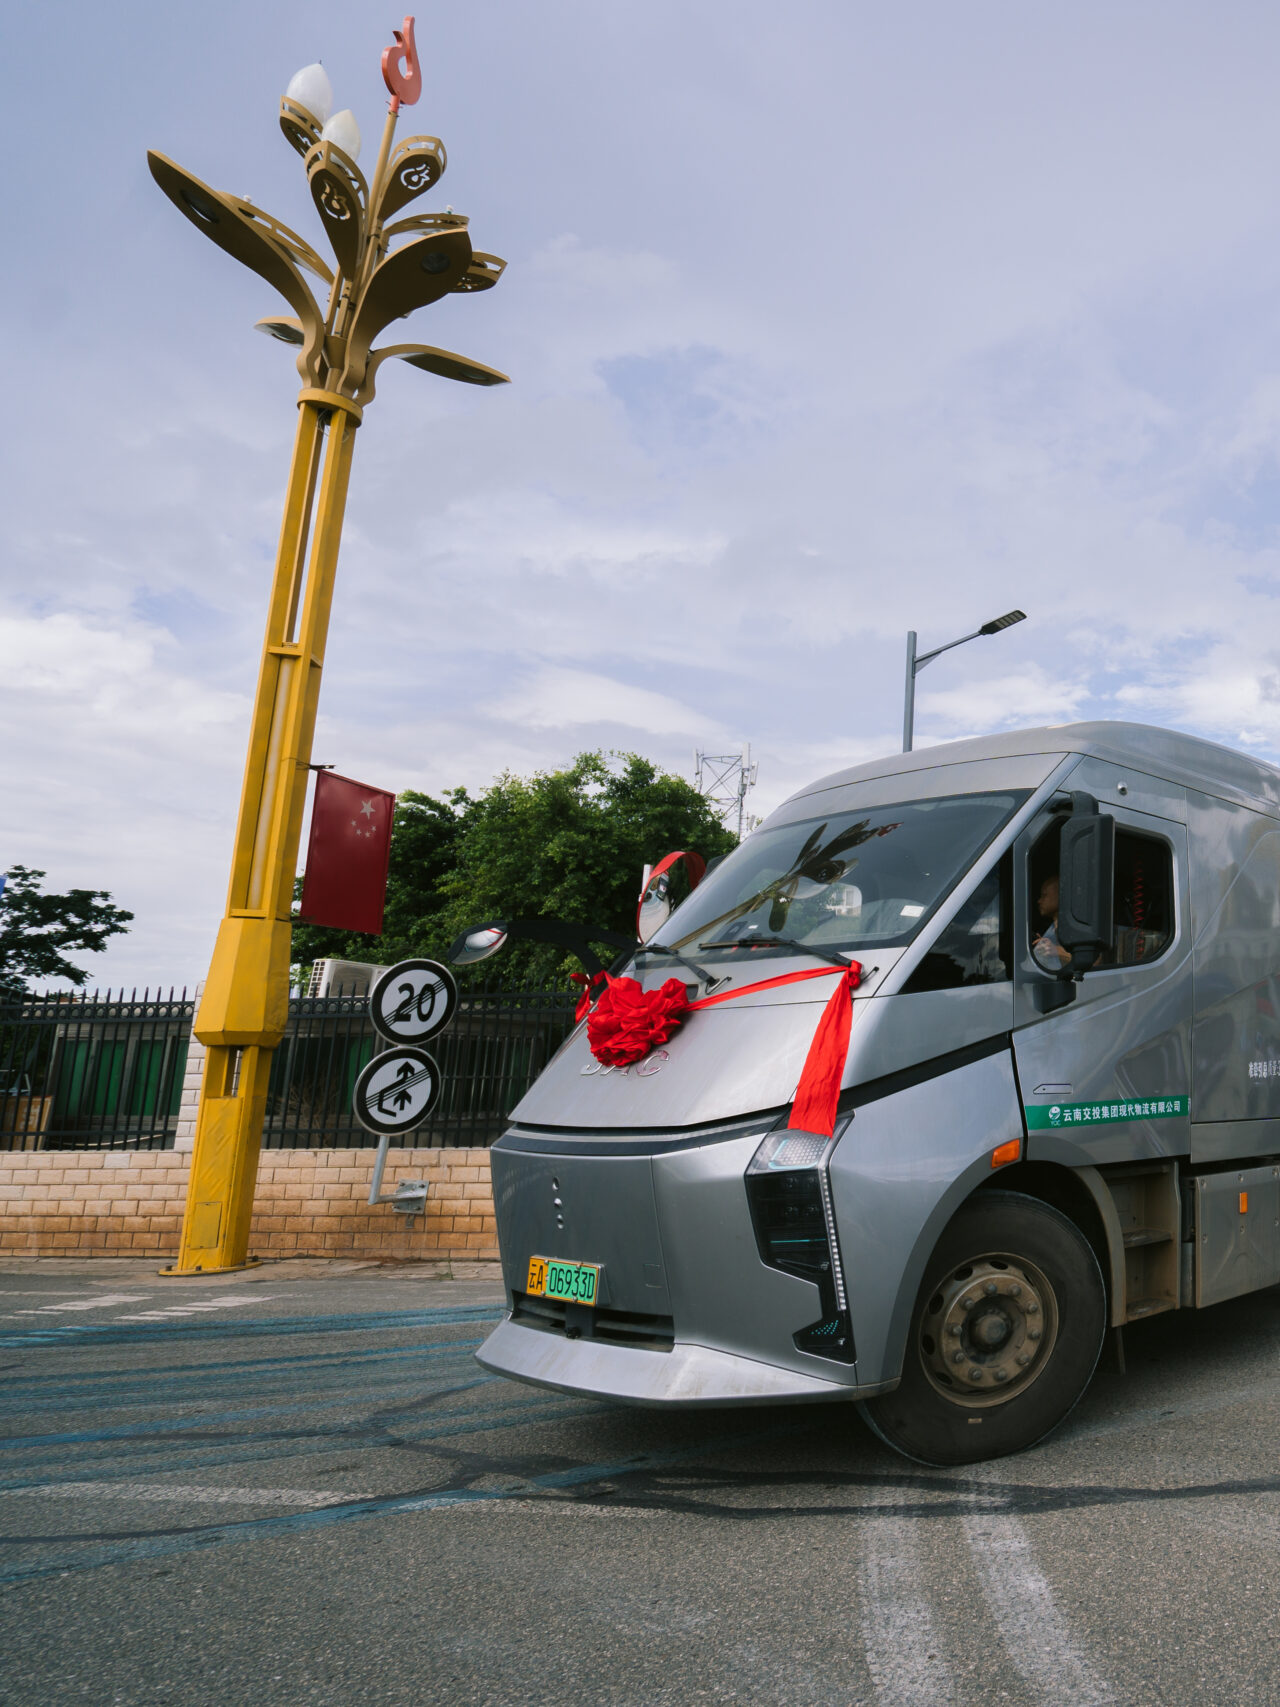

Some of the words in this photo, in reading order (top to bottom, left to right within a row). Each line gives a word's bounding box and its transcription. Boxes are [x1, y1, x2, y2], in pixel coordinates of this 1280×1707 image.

[397, 982, 436, 1022] 20
[1063, 1100, 1181, 1122] 云南交投集团现代物流有限公司
[529, 1264, 595, 1299] 云A06933D
